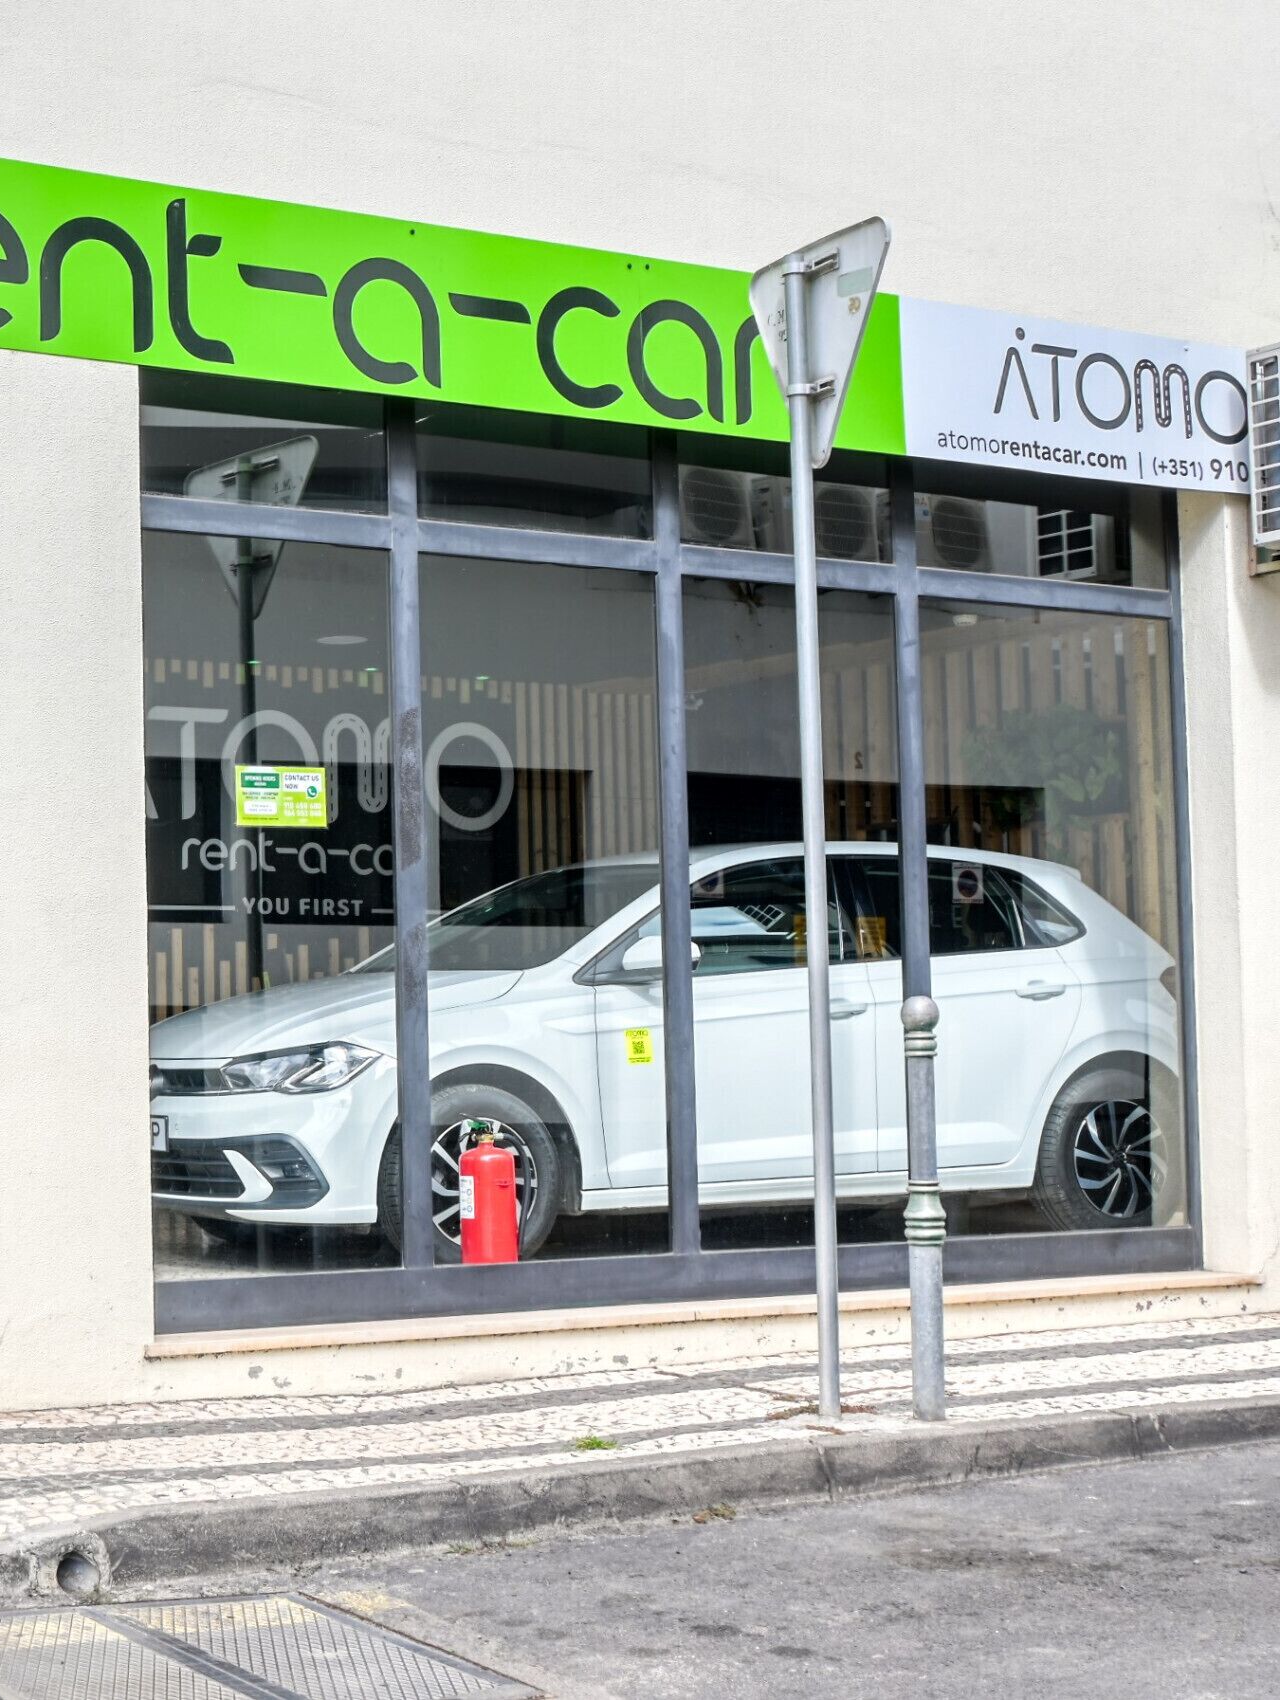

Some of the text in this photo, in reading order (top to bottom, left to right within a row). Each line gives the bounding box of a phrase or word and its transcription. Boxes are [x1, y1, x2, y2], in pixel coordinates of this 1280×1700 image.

[937, 430, 1250, 485] atomorentacar.com (+351) 910
[145, 705, 515, 832] TOMO
[284, 774, 320, 782] CONTACT US
[181, 831, 394, 877] rent-a-ca
[242, 897, 364, 917] YOU FIRST
